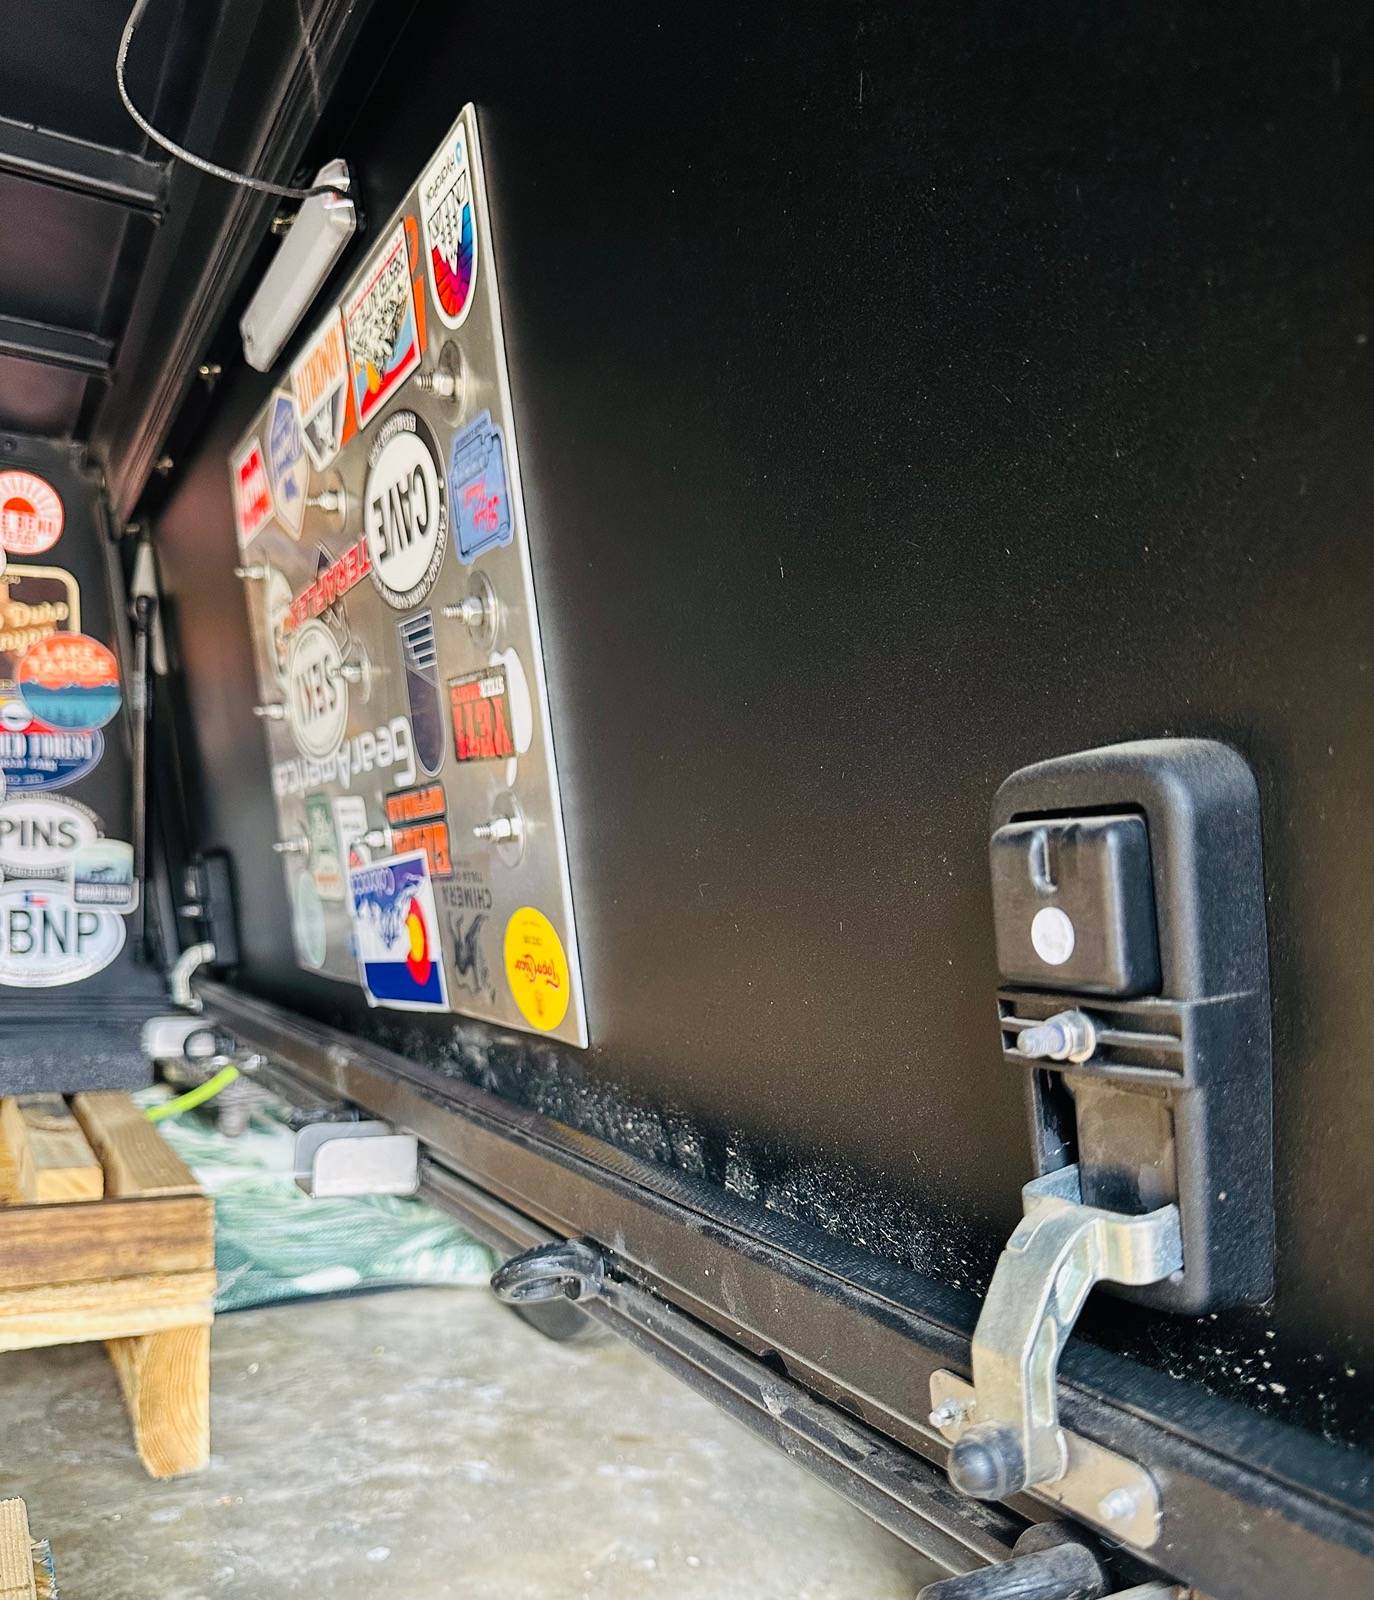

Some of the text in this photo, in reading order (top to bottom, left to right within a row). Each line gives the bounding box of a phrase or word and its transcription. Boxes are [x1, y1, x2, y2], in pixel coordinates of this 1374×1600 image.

[373, 463, 428, 563] CAVE
[28, 656, 110, 673] TAHOE
[40, 644, 95, 657] LAKE
[453, 696, 511, 761] YETI
[0, 819, 77, 848] PINS
[442, 886, 492, 909] CHIMERA
[0, 909, 99, 954] BNP
